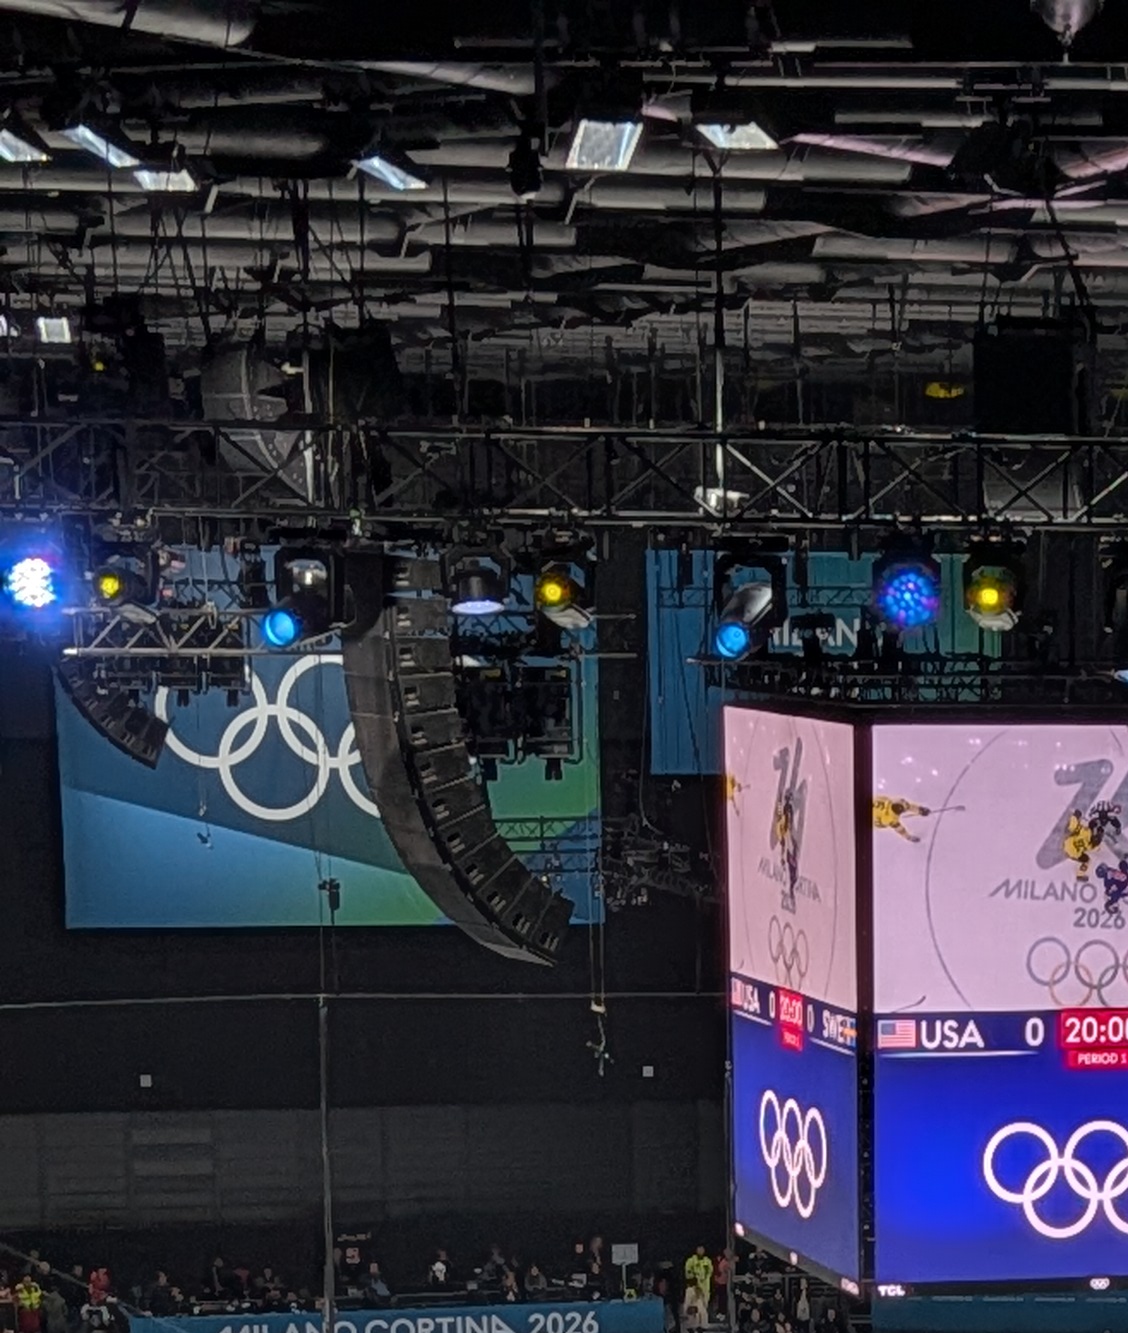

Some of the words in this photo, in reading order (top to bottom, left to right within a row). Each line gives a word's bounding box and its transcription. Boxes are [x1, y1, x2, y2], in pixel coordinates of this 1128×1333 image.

[989, 878, 1098, 903] MILANO
[1073, 907, 1126, 930] 2026
[920, 1018, 985, 1049] USA
[1024, 1017, 1045, 1047] 0
[1077, 1052, 1119, 1065] PERIOD
[877, 1284, 906, 1297] TCL
